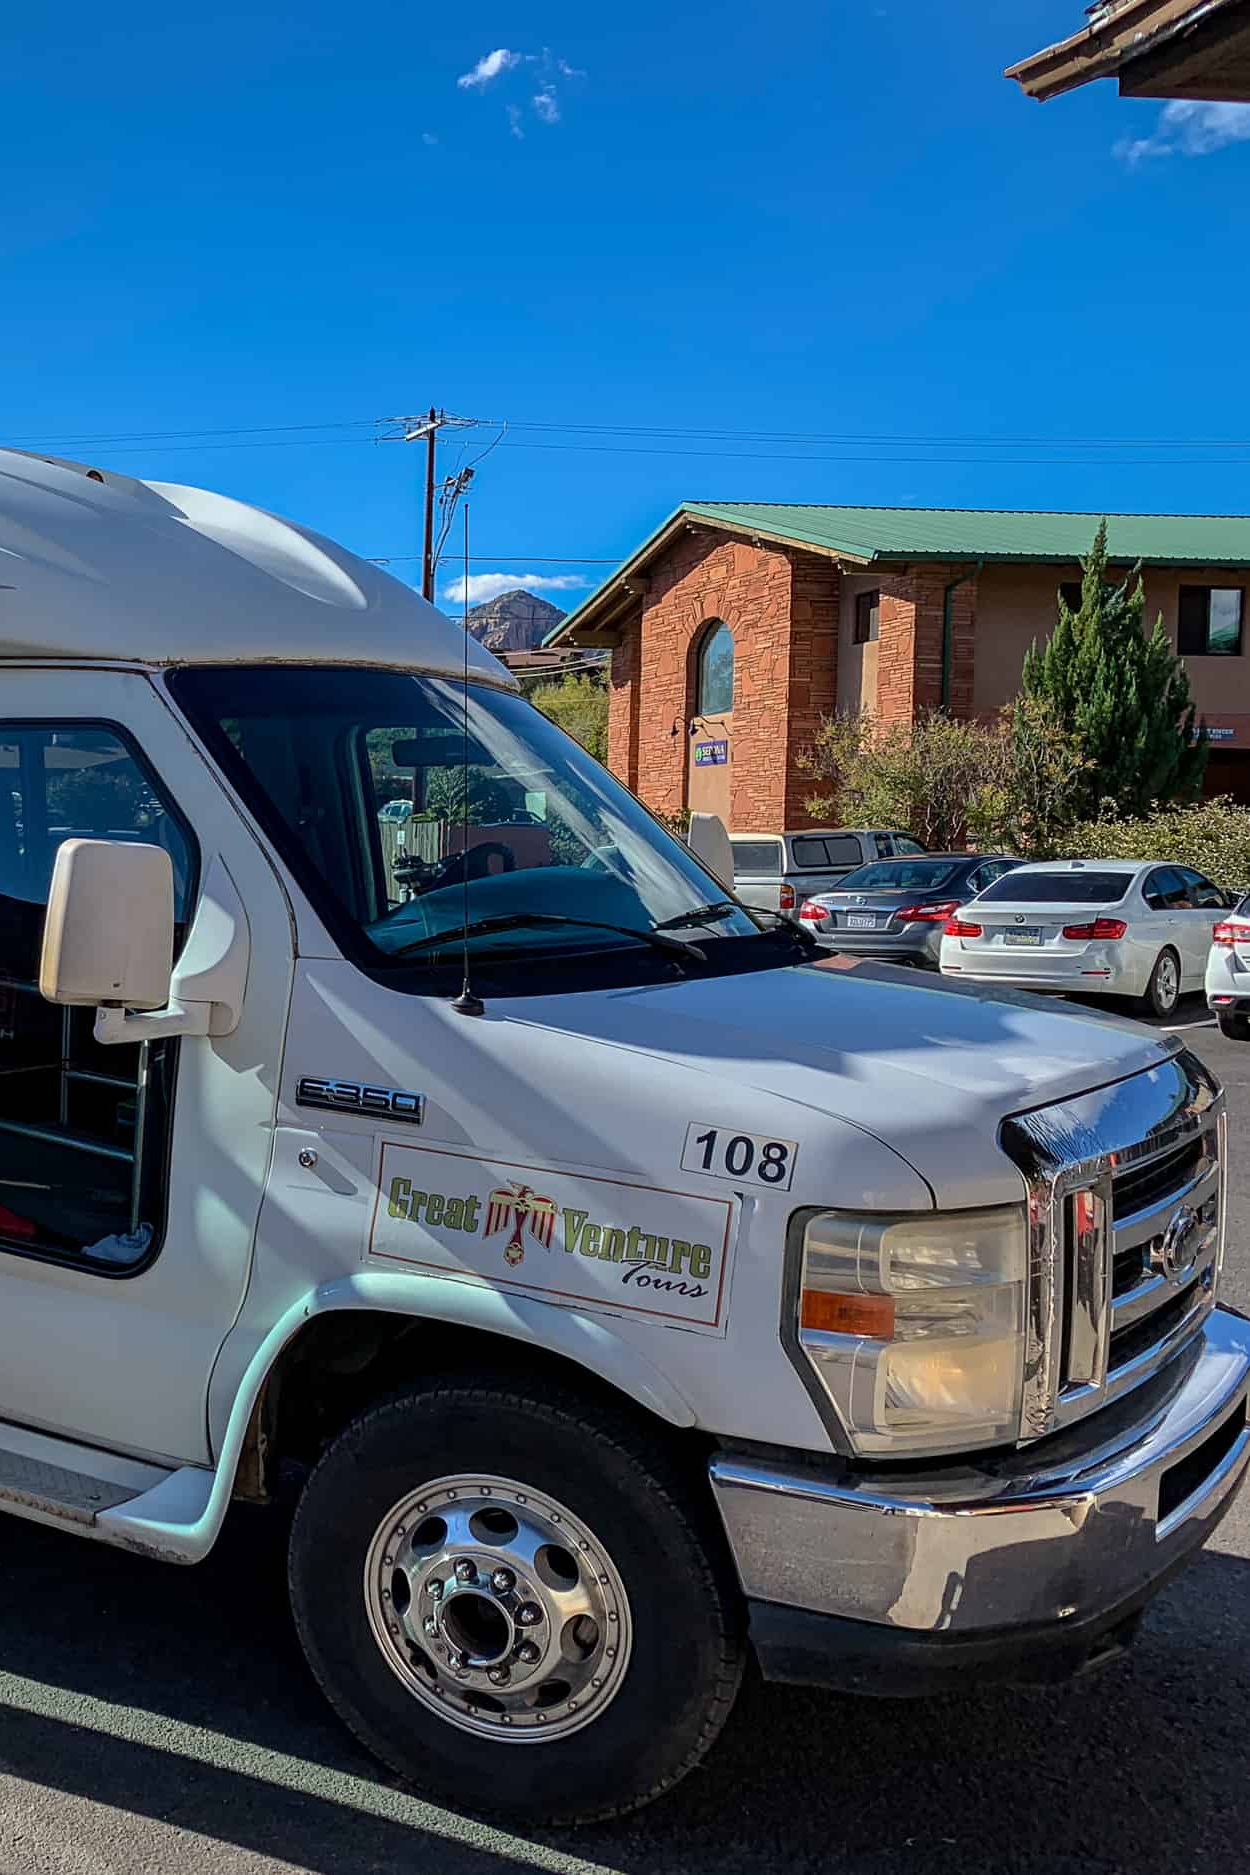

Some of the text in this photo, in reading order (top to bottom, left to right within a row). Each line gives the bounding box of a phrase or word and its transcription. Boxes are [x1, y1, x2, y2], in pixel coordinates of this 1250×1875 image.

[702, 744, 725, 757] SEDNA
[696, 1130, 788, 1183] 108
[389, 1176, 712, 1279] Great Venture
[620, 1259, 709, 1298] Tours
